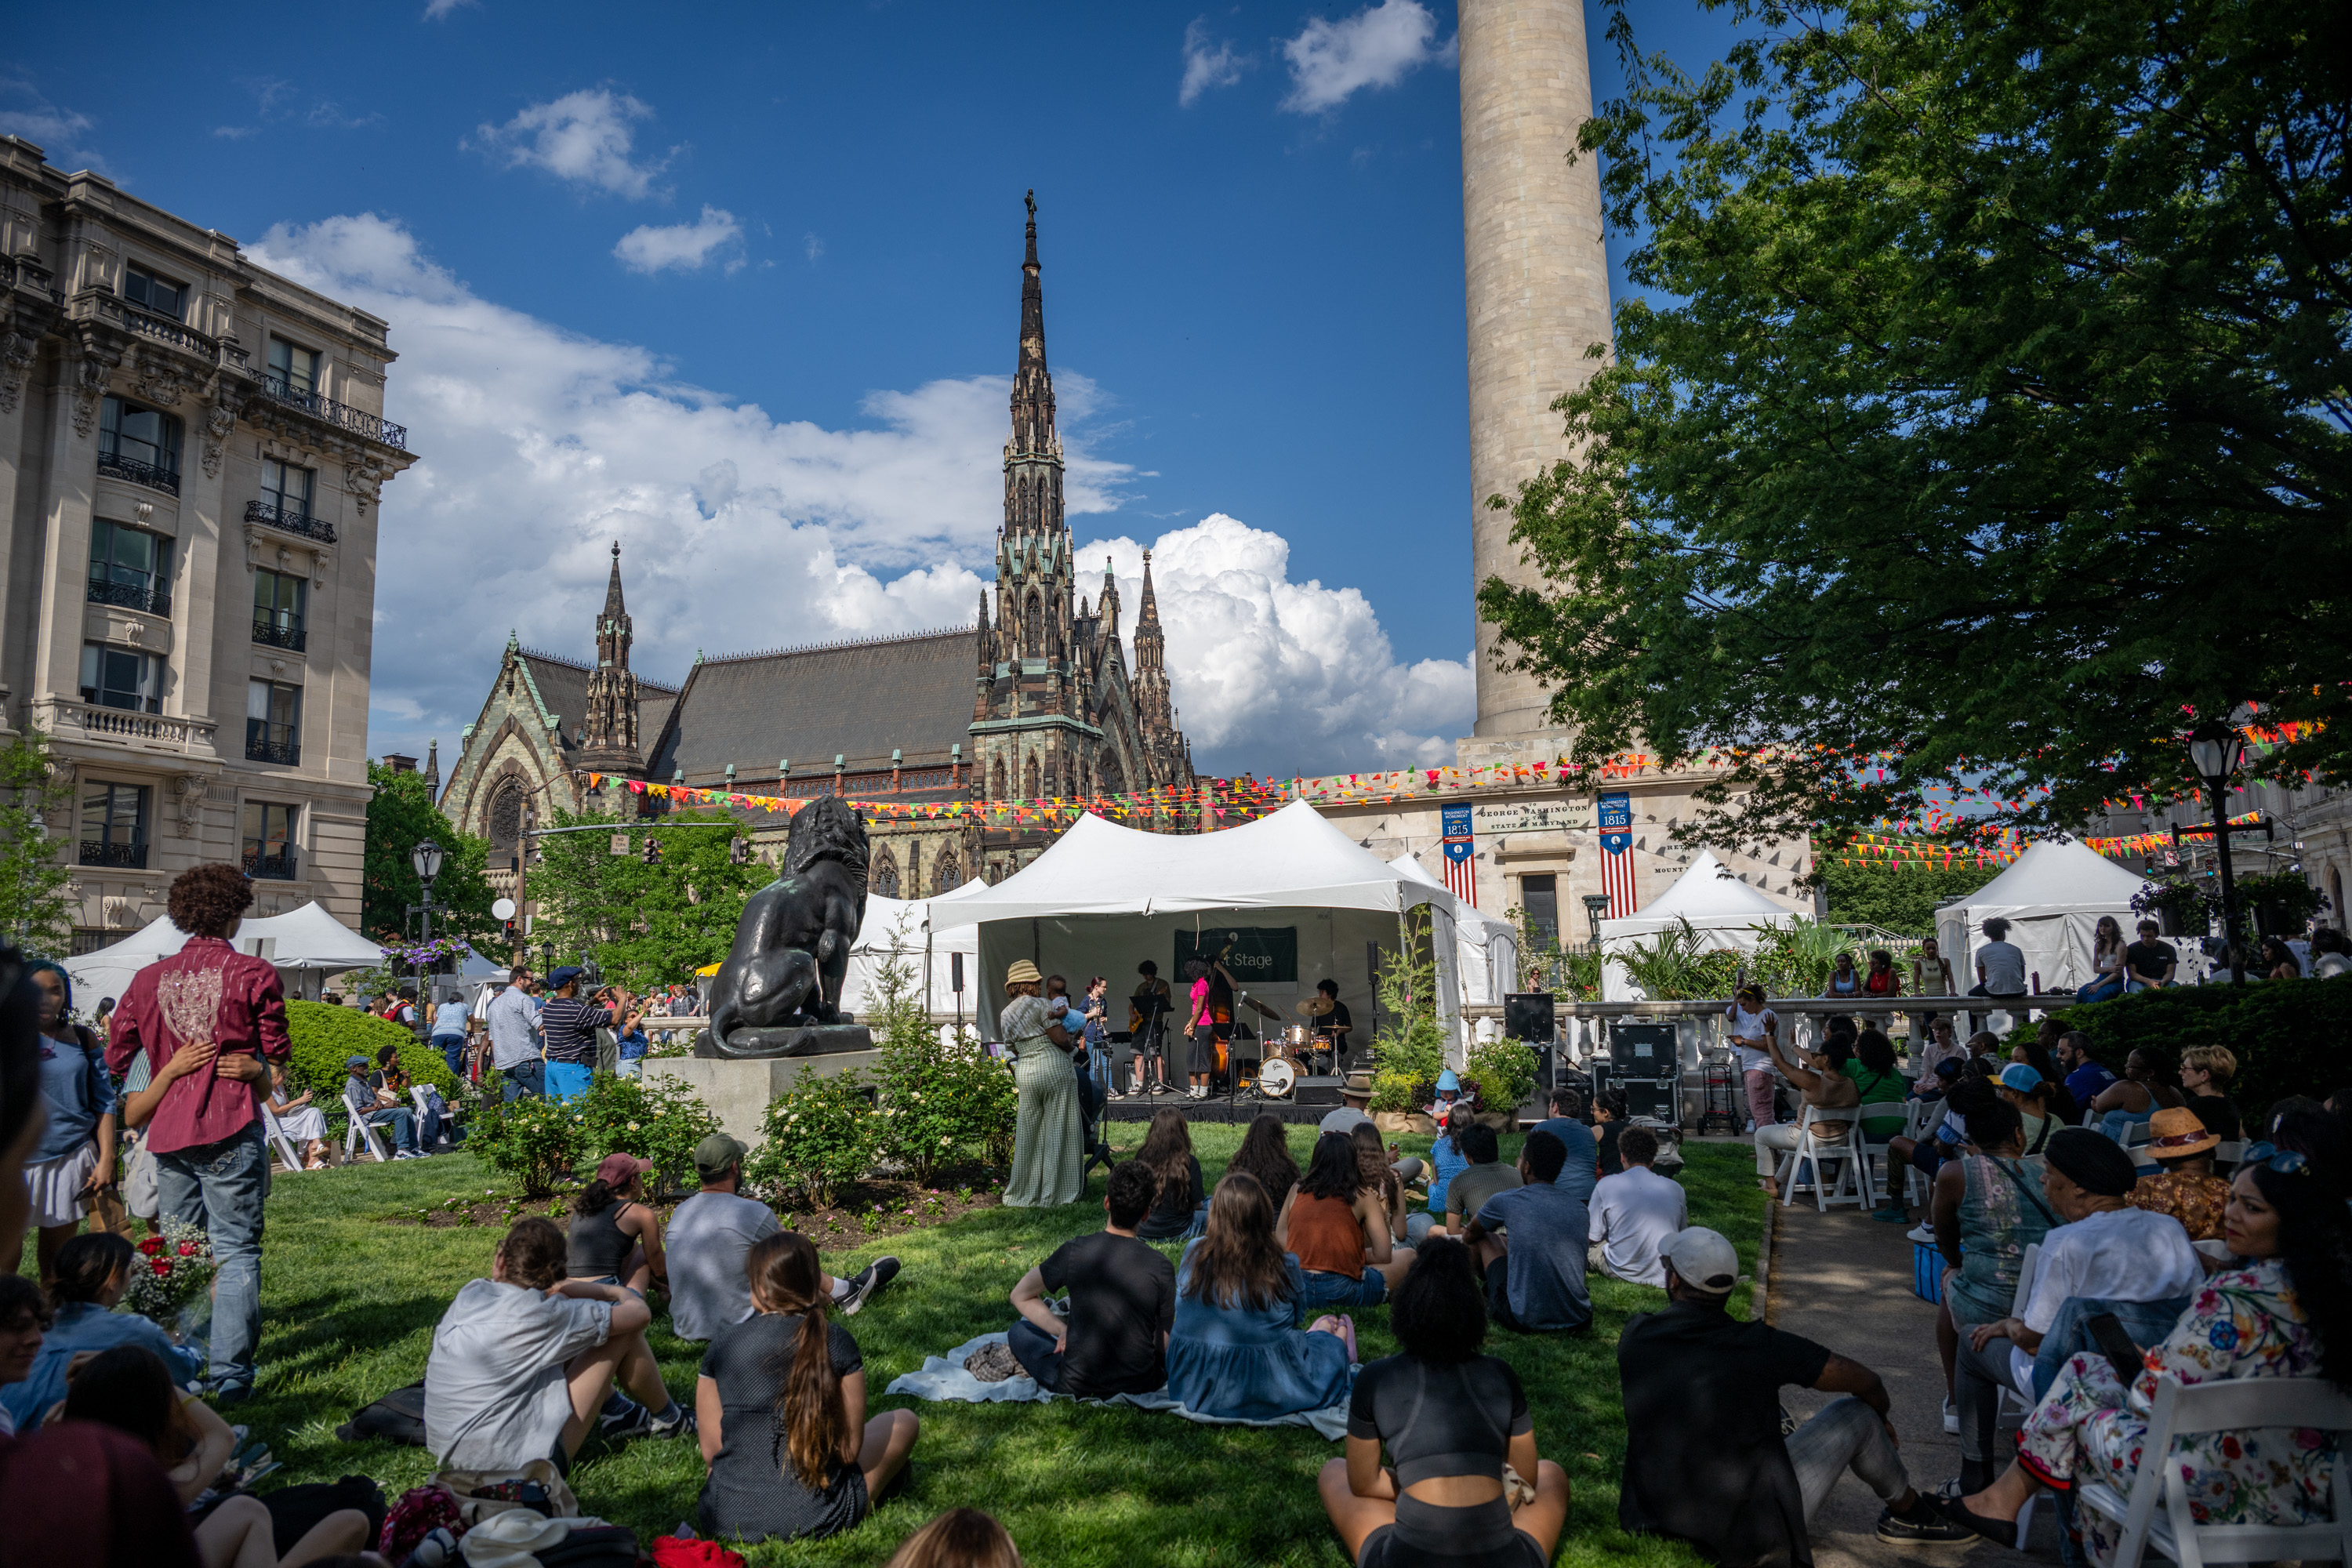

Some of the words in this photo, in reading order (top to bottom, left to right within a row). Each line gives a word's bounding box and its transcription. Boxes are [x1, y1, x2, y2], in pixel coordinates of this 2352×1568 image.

[1524, 805, 1588, 815] WASHINGTON
[1604, 815, 1626, 825] 1815
[1447, 825, 1468, 834] 1815
[1235, 953, 1272, 969] Stage
